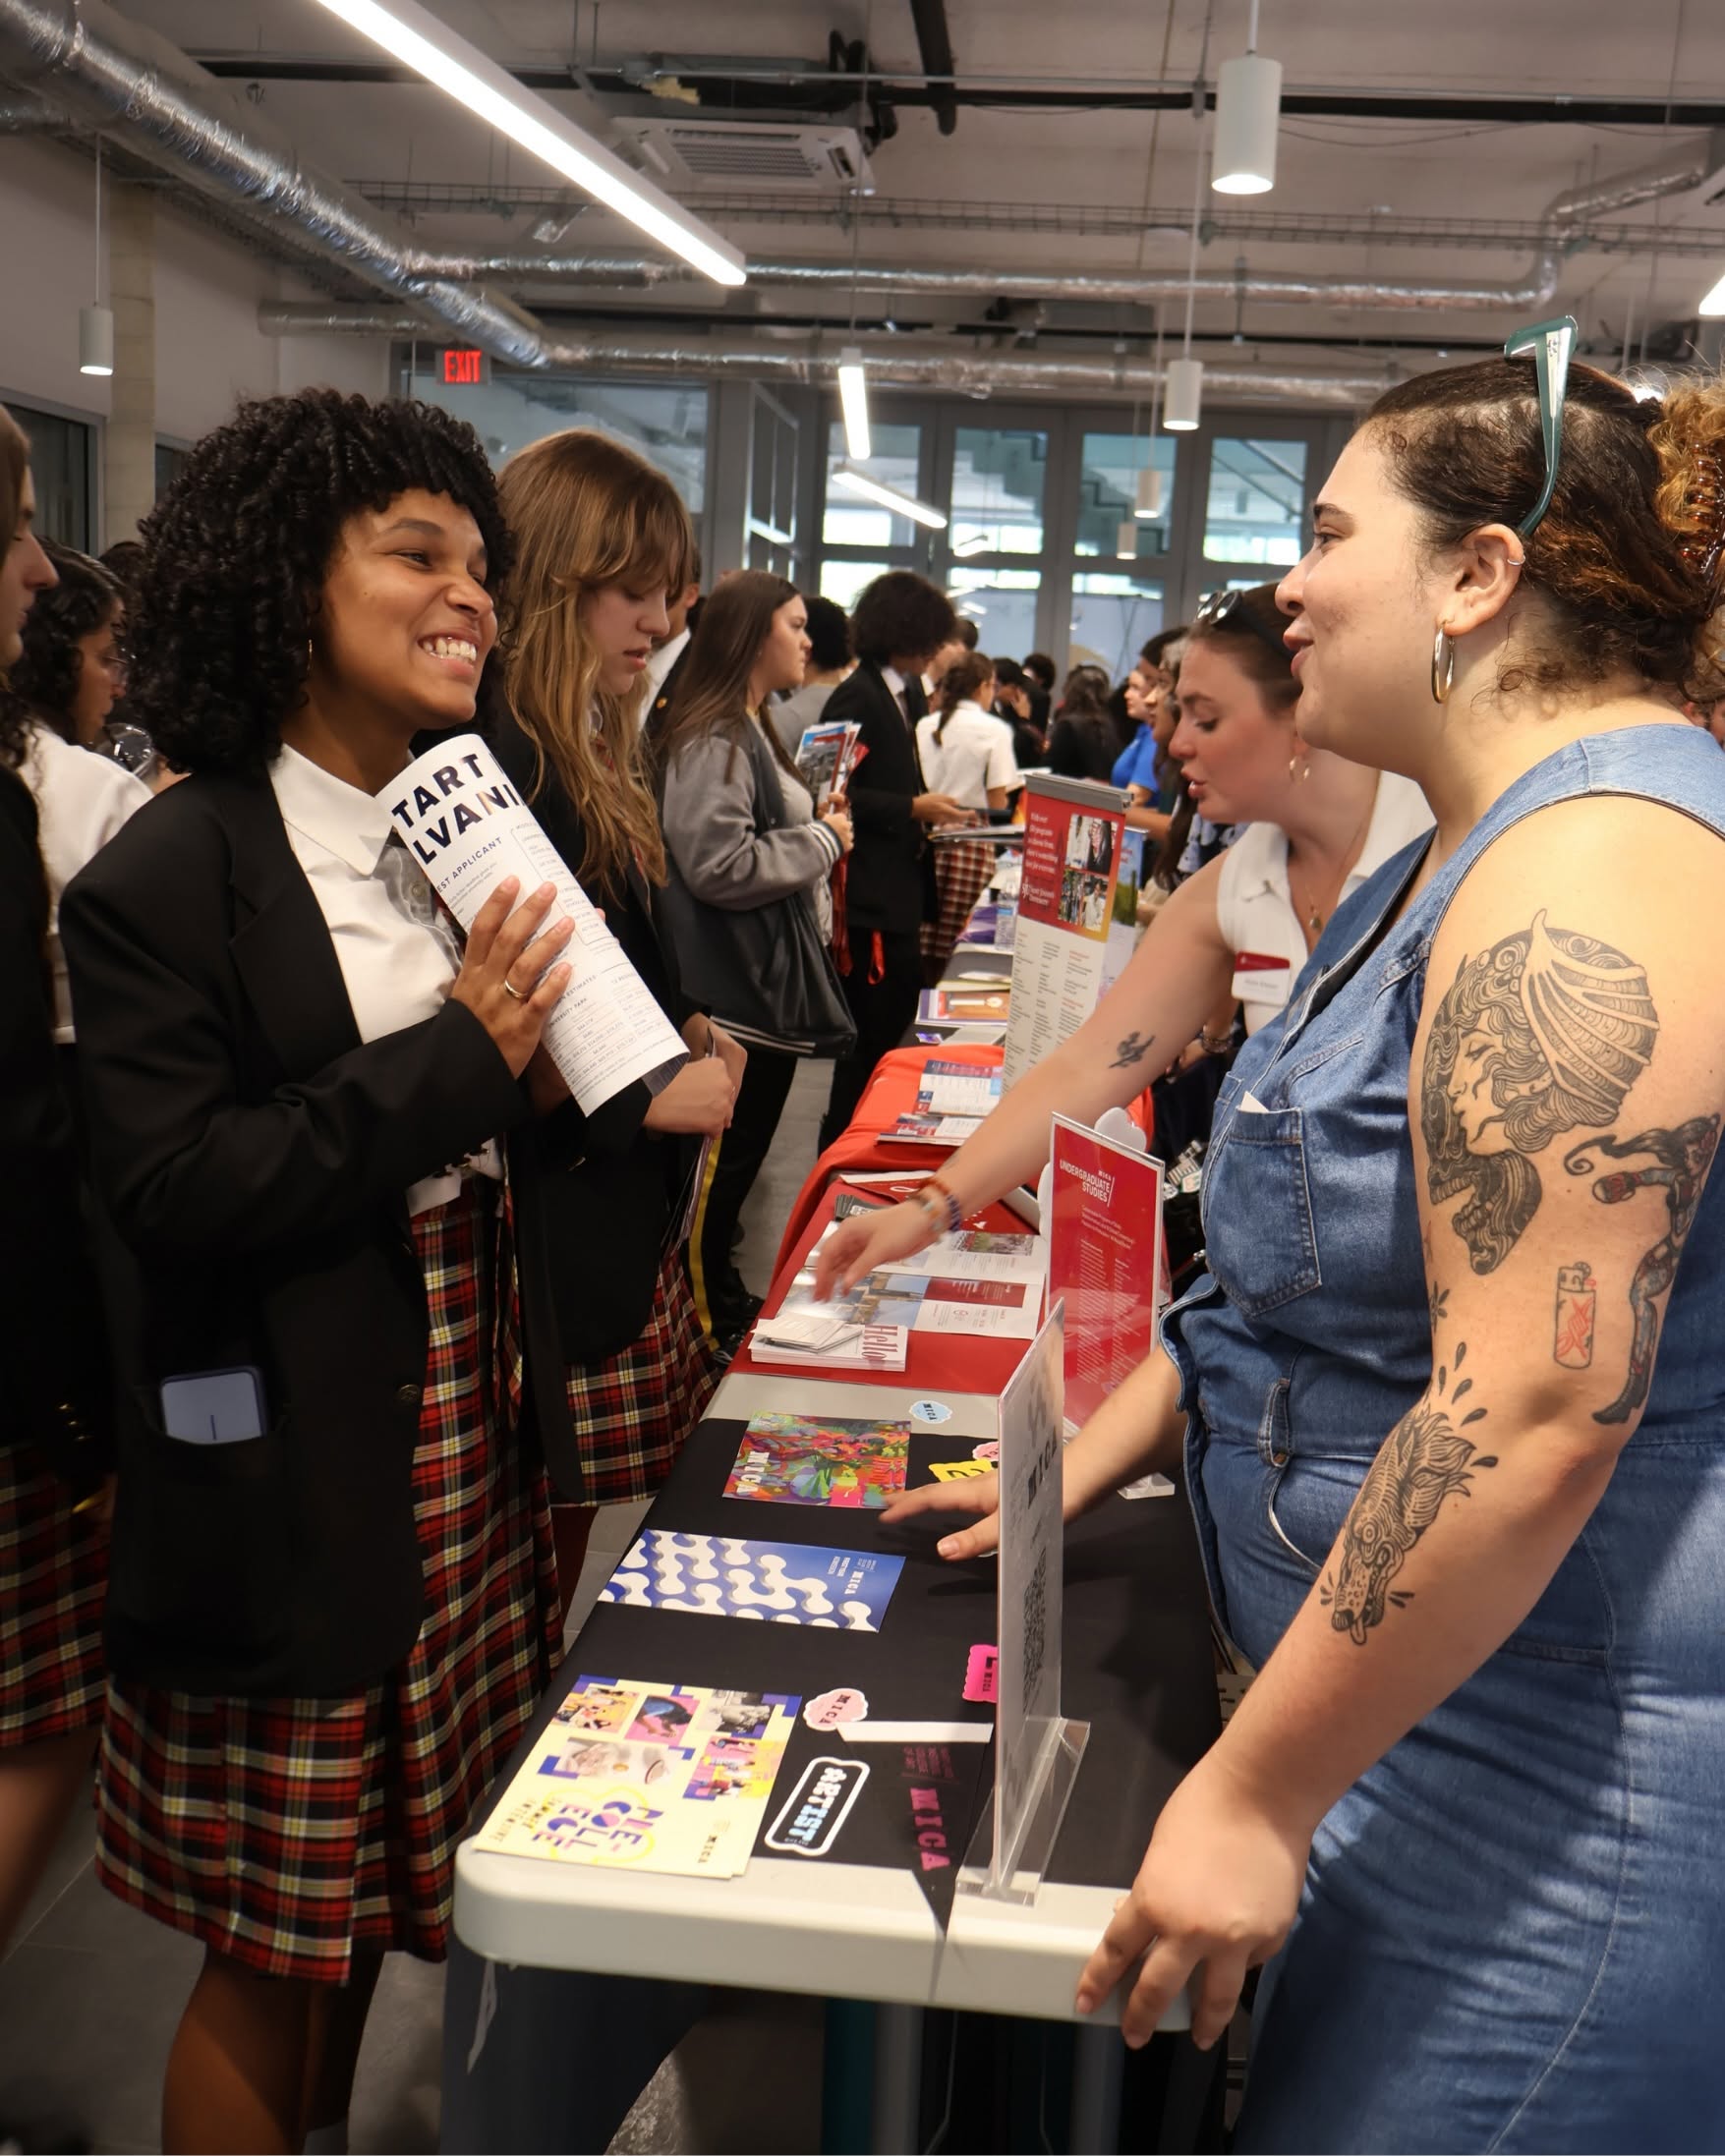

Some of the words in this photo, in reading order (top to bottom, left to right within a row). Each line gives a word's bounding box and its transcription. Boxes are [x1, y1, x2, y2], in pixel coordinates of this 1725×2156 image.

[444, 350, 482, 383] EXIT
[391, 753, 484, 828] TART
[413, 783, 523, 866] LVANI
[452, 836, 503, 879] APPLICANT
[1059, 1159, 1111, 1193] UNDERGRADUATE
[1081, 1181, 1108, 1203] STUDIES
[861, 1323, 898, 1362] Hello
[922, 1402, 939, 1421] MICA
[735, 1449, 771, 1496] MICA
[1027, 1425, 1057, 1510] MICA
[844, 1570, 865, 1596] MICA
[819, 1693, 851, 1725] MICA
[787, 1766, 848, 1843] ARTIST
[909, 1787, 951, 1872] MICA
